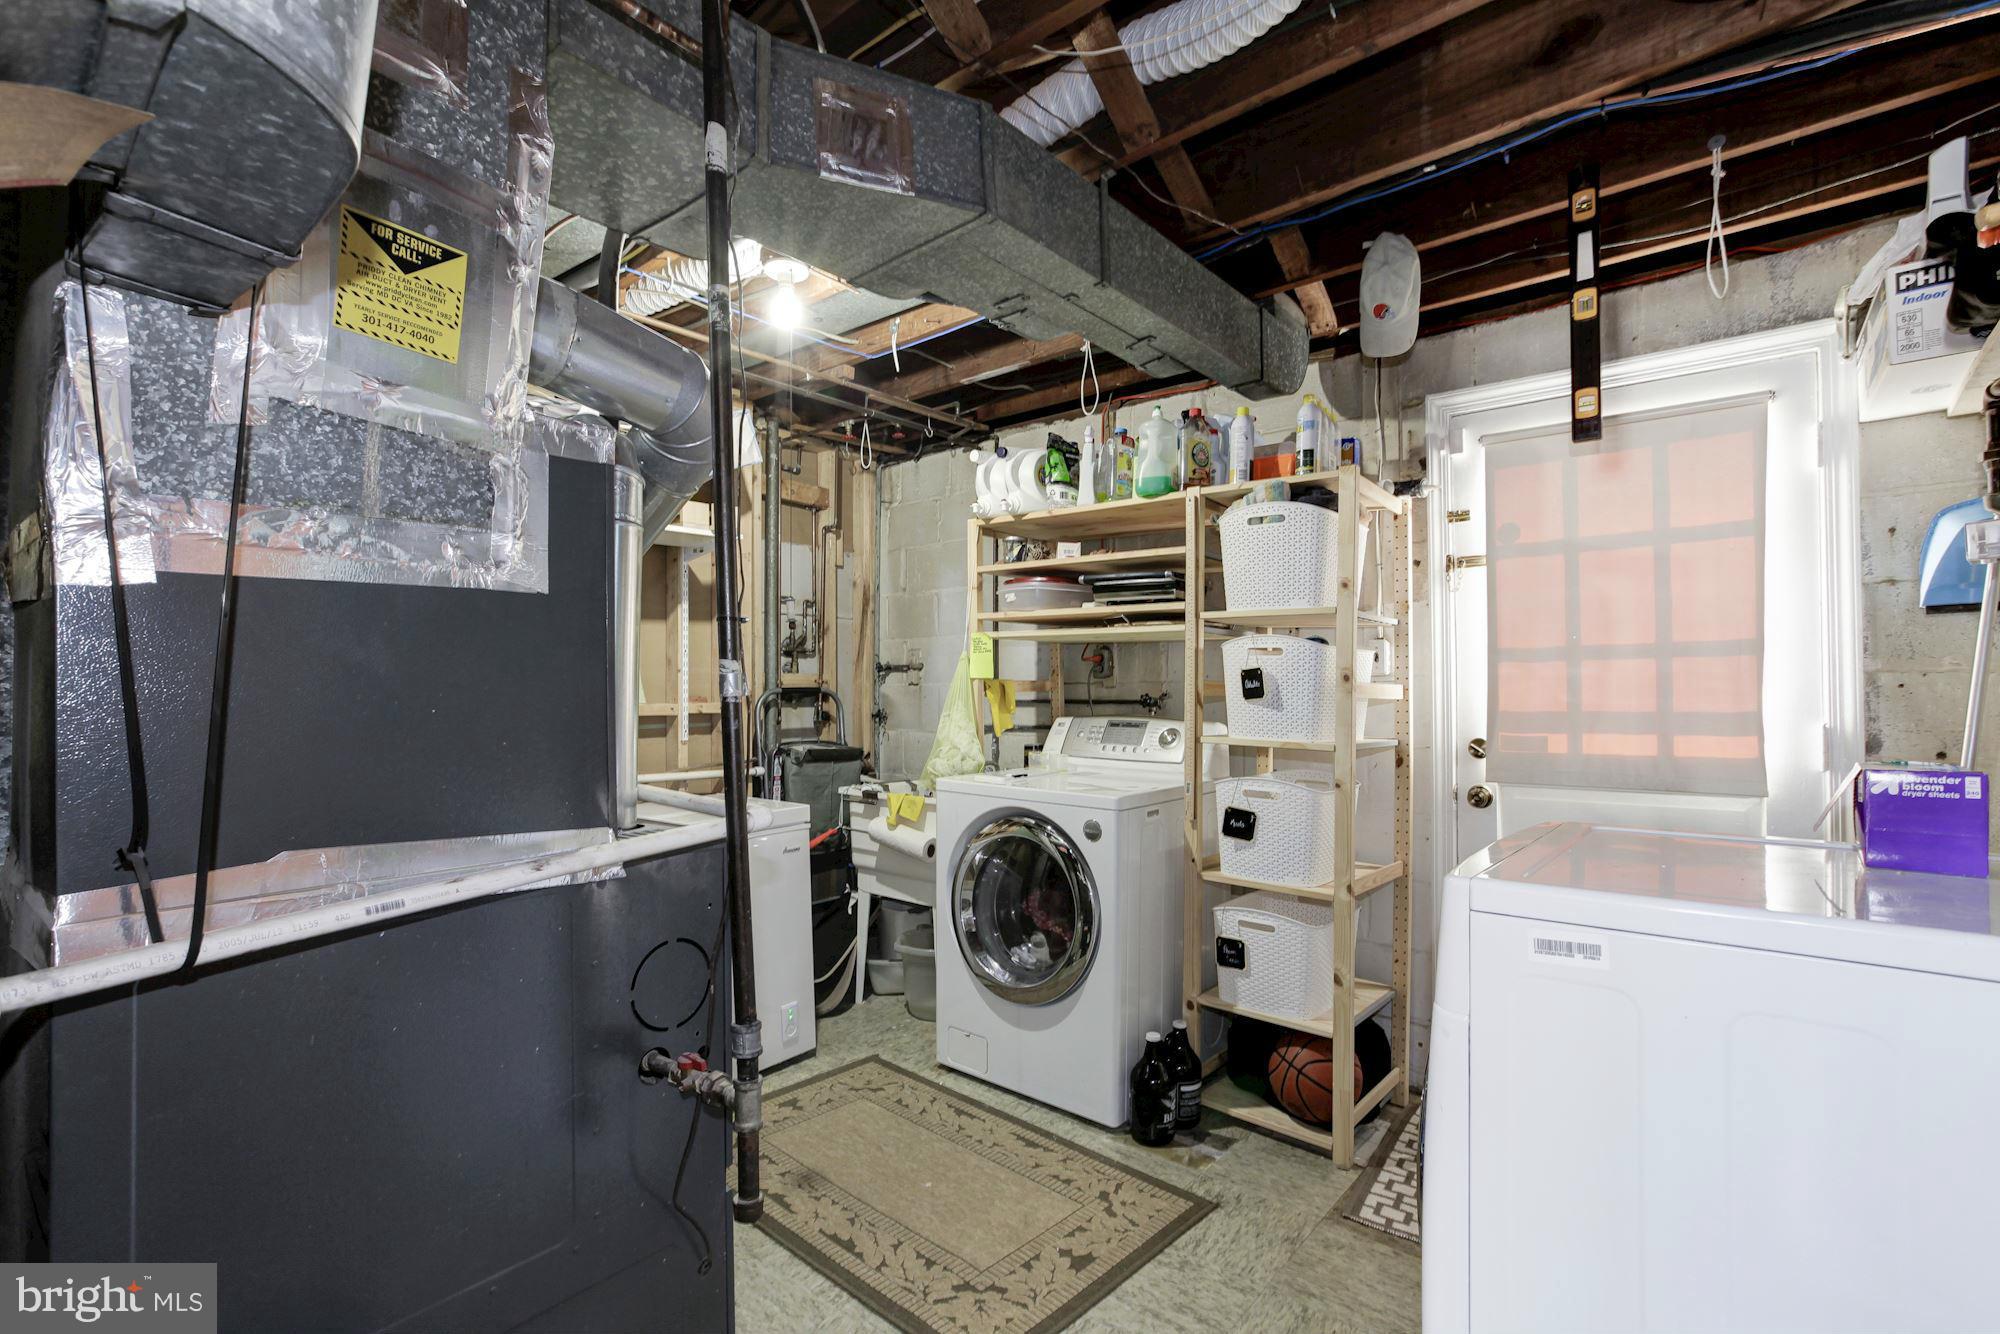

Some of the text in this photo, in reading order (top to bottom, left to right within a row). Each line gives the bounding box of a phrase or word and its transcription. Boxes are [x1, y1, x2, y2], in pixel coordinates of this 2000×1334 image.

[371, 222, 443, 260] FOR SERVICE
[391, 243, 422, 265] CALL:
[356, 269, 370, 279] AIR
[372, 274, 392, 286] DUCT
[403, 284, 427, 298] DRYER
[429, 295, 447, 305] VENT
[357, 262, 447, 298] PRIDDY CLEAN CHIMNEY
[346, 279, 453, 321] Serving MD DC VA Since 1982
[1902, 289, 1949, 305] Indoor
[353, 303, 375, 315] YEARLY
[377, 310, 401, 323] SERVICE
[361, 313, 435, 344] 301-417-4040
[1900, 341, 1921, 352] 2000
[1901, 790, 1961, 799] dryer sheets
[1902, 782, 1945, 792] bloom
